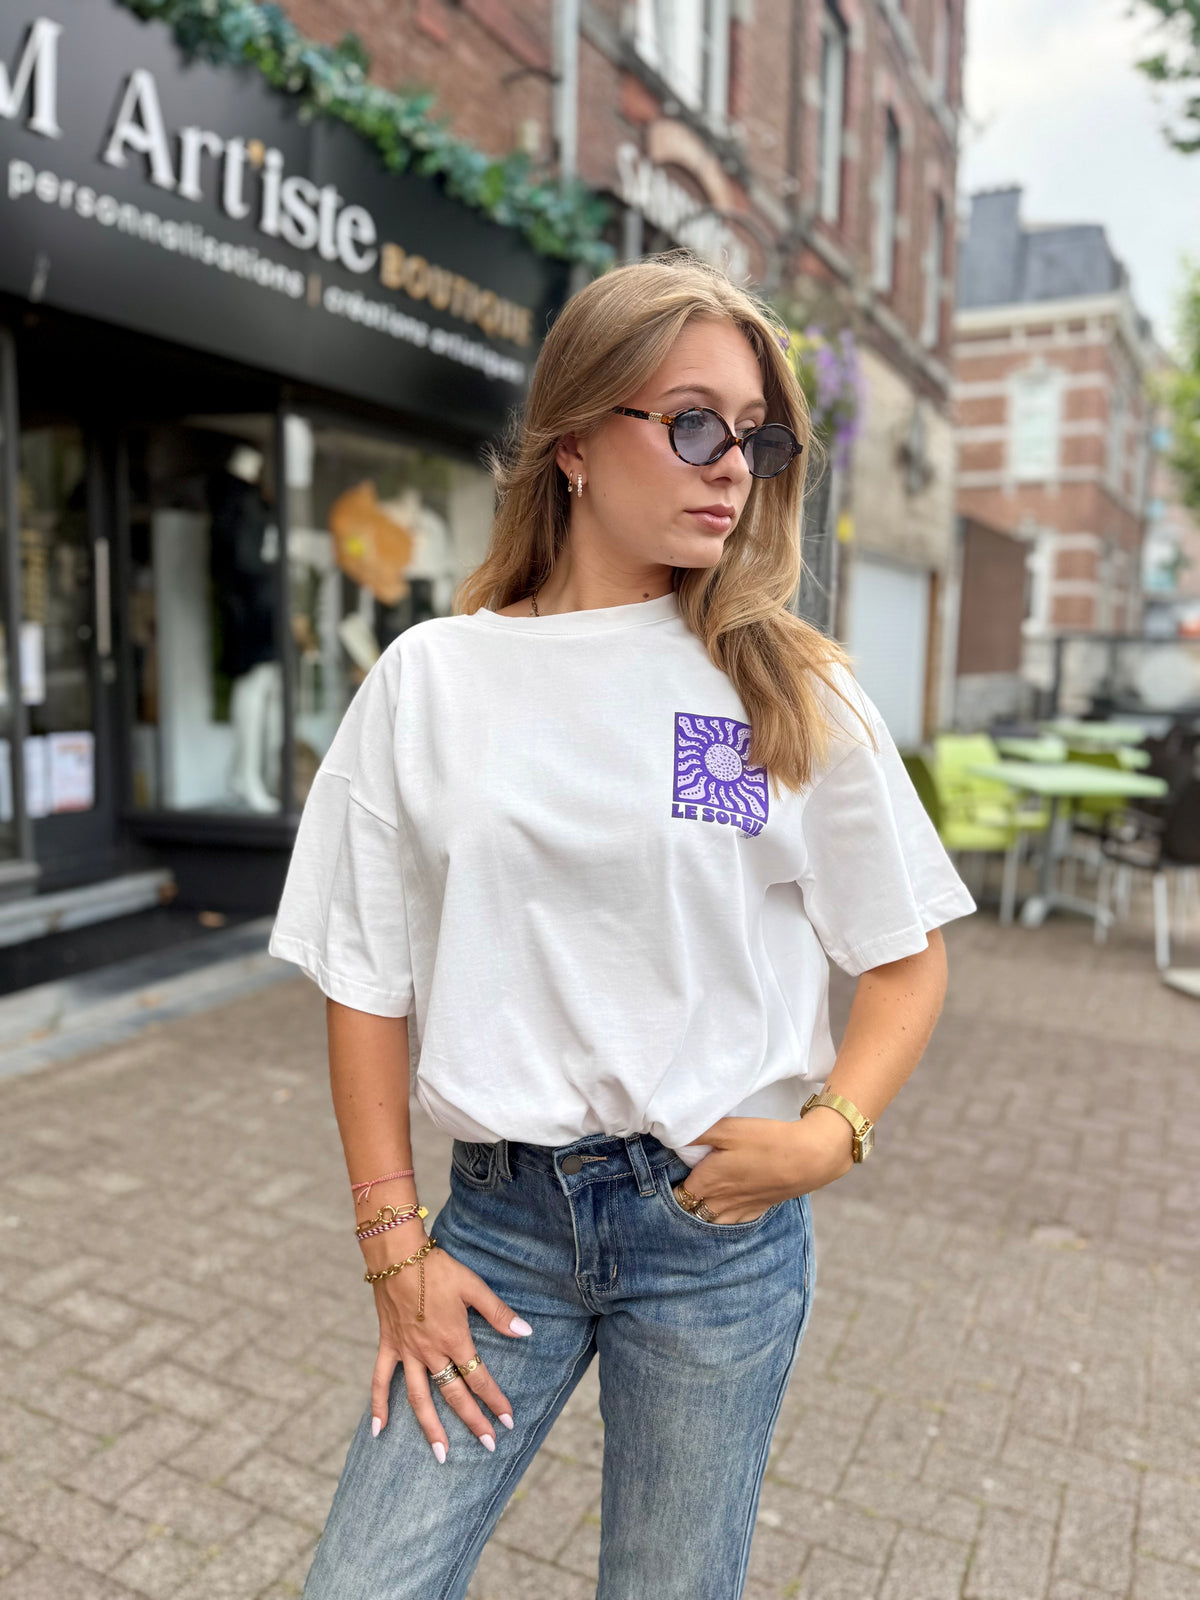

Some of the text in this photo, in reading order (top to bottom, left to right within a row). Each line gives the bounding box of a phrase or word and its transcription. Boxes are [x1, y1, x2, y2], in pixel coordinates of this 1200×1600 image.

[8, 159, 304, 298] personnalisations
[380, 243, 533, 347] BOUTIQUE
[671, 803, 698, 820] LE
